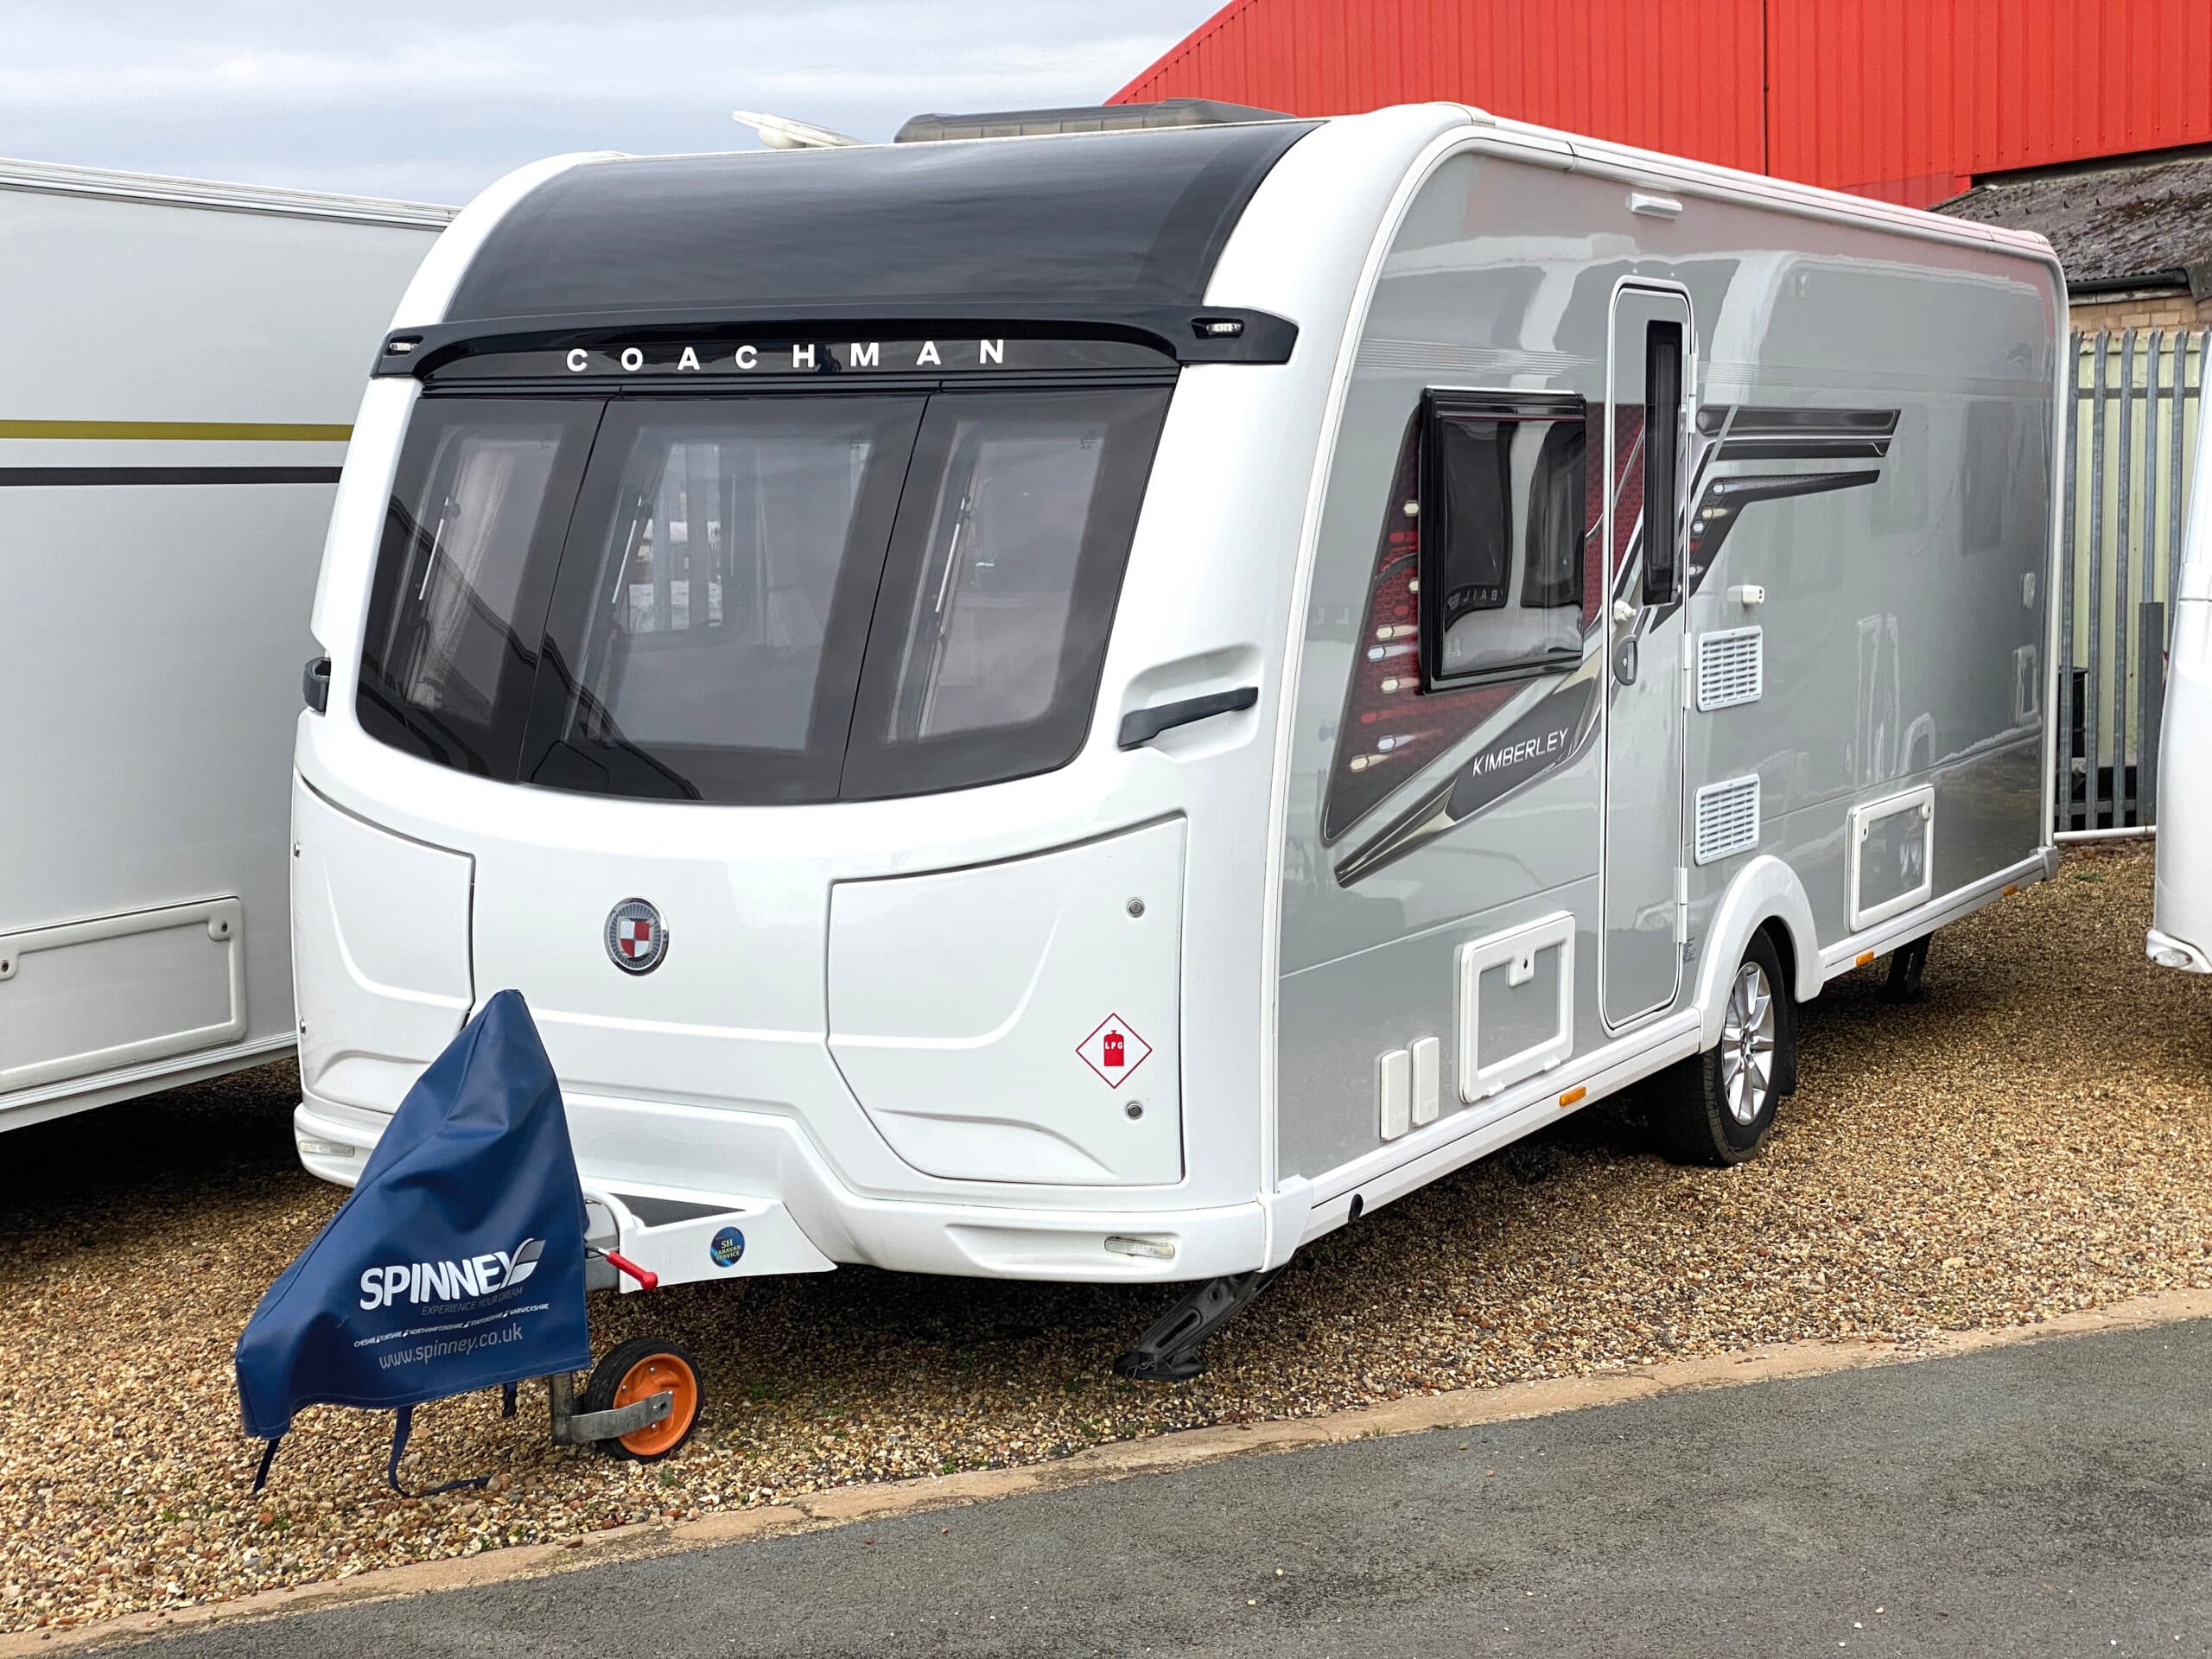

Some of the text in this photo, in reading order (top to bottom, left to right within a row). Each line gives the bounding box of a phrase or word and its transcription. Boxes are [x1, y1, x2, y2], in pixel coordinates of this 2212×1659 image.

[566, 339, 1004, 372] COACHMAN
[1472, 727, 1569, 778] KIMBERLEY
[721, 1239, 733, 1249] SH
[359, 1239, 541, 1310] SPINNEY
[409, 1322, 465, 1336] NORTHAMPTONSHIRE
[509, 1302, 550, 1315] WARWICKSHIRE
[421, 1301, 478, 1315] EXPERIENCE
[378, 1322, 524, 1370] www.spinney.co.uk
